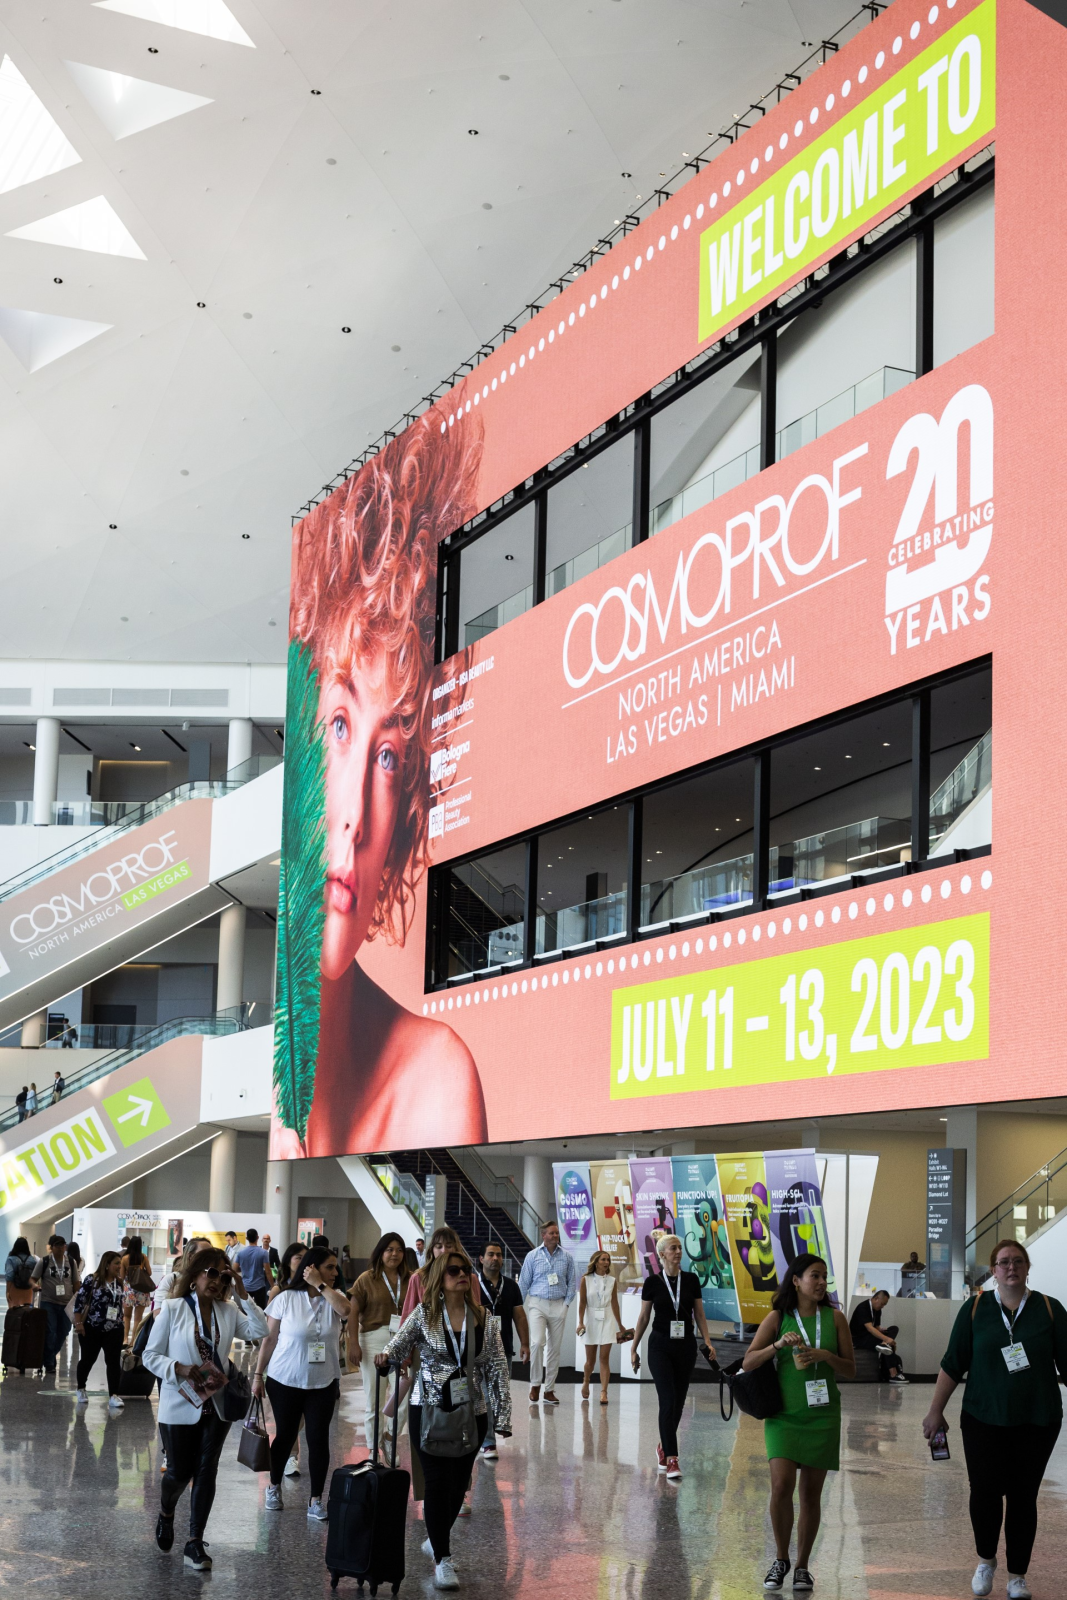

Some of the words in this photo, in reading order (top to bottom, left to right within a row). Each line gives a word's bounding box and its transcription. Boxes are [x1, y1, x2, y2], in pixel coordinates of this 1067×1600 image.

[708, 88, 907, 318] WELCOME
[917, 34, 982, 157] TO
[885, 384, 994, 616] 20
[887, 502, 995, 566] CELEBRATING
[562, 441, 869, 688] COSMOPROF
[884, 574, 992, 656] YEARS
[469, 661, 485, 681] BEAUTY
[618, 664, 681, 720] NORTH
[689, 619, 782, 684] AMERICA
[606, 725, 638, 764] LAS
[644, 694, 709, 747] VEGAS
[731, 656, 796, 712] MIAMI
[442, 740, 471, 763] Bologna
[442, 763, 457, 778] Fiere
[445, 790, 472, 810] Professional
[445, 808, 460, 821] Beauty
[445, 816, 470, 832] Association
[10, 830, 178, 943] COSMOPROF
[28, 932, 69, 959] NORTH
[73, 903, 123, 936] AMERICA
[125, 889, 147, 907] LAS
[148, 866, 188, 892] VEGAS
[617, 994, 694, 1084] JULY
[701, 986, 734, 1071] 11
[780, 968, 837, 1075] 13,
[850, 939, 975, 1054] 2023
[0, 1116, 107, 1209] ATION
[560, 1193, 588, 1206] COSMO
[636, 1192, 648, 1201] SKIN
[649, 1191, 669, 1201] SHRINK
[677, 1191, 706, 1200] FUNCTION
[706, 1190, 718, 1199] UP!
[725, 1194, 755, 1203] FRUITOPIA
[126, 1218, 162, 1228] Awards
[560, 1206, 591, 1220] TRENDS
